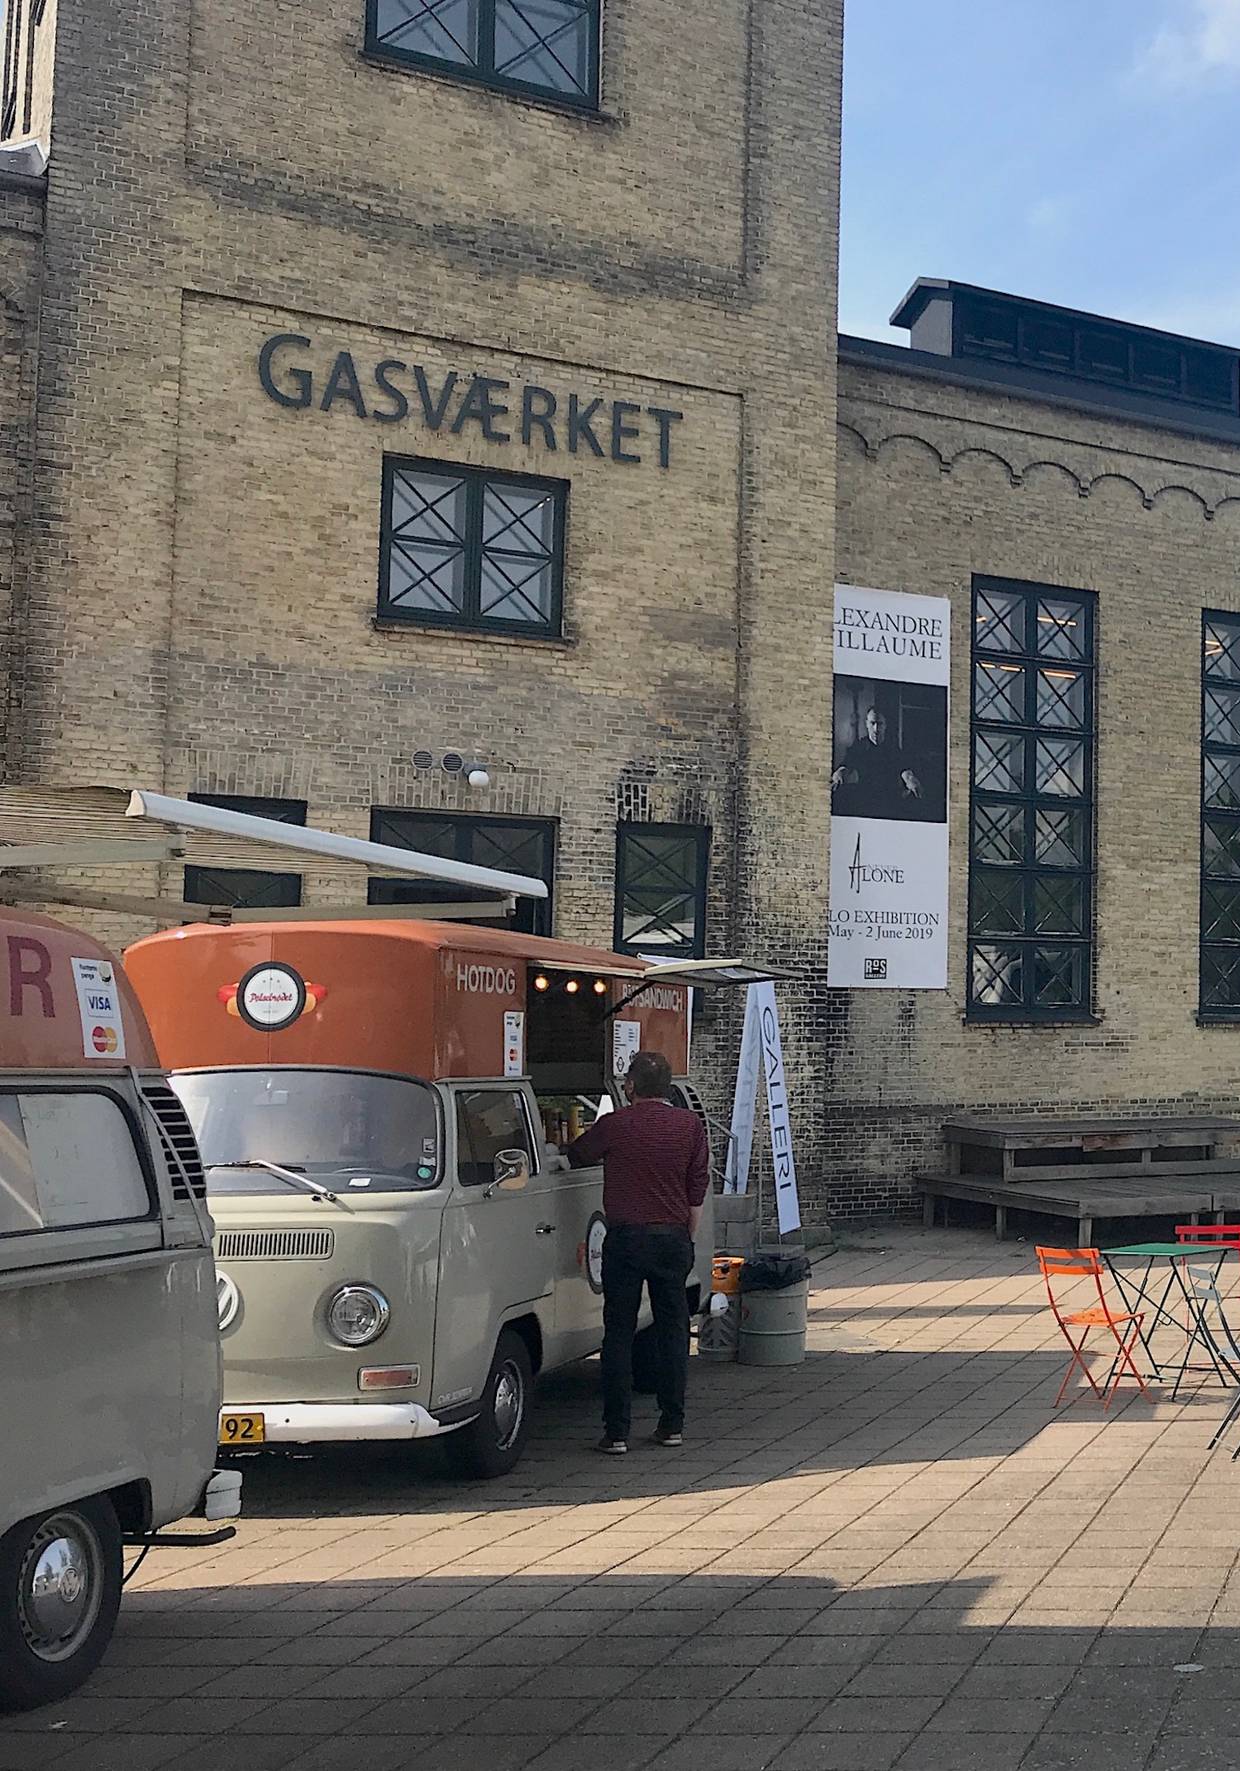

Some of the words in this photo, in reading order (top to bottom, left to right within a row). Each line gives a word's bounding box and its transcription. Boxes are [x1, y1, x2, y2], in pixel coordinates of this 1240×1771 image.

[258, 334, 683, 469] GASVÆRKET
[832, 628, 942, 660] ILLAUME
[854, 910, 940, 925] EXHIBITION
[865, 926, 873, 938] 2
[875, 926, 903, 941] June
[905, 928, 933, 940] 2019
[7, 935, 56, 1018] R
[457, 963, 516, 995] HOTDOG
[88, 996, 111, 1011] VISA
[763, 1006, 792, 1190] GALLERI
[225, 1418, 255, 1439] 92
